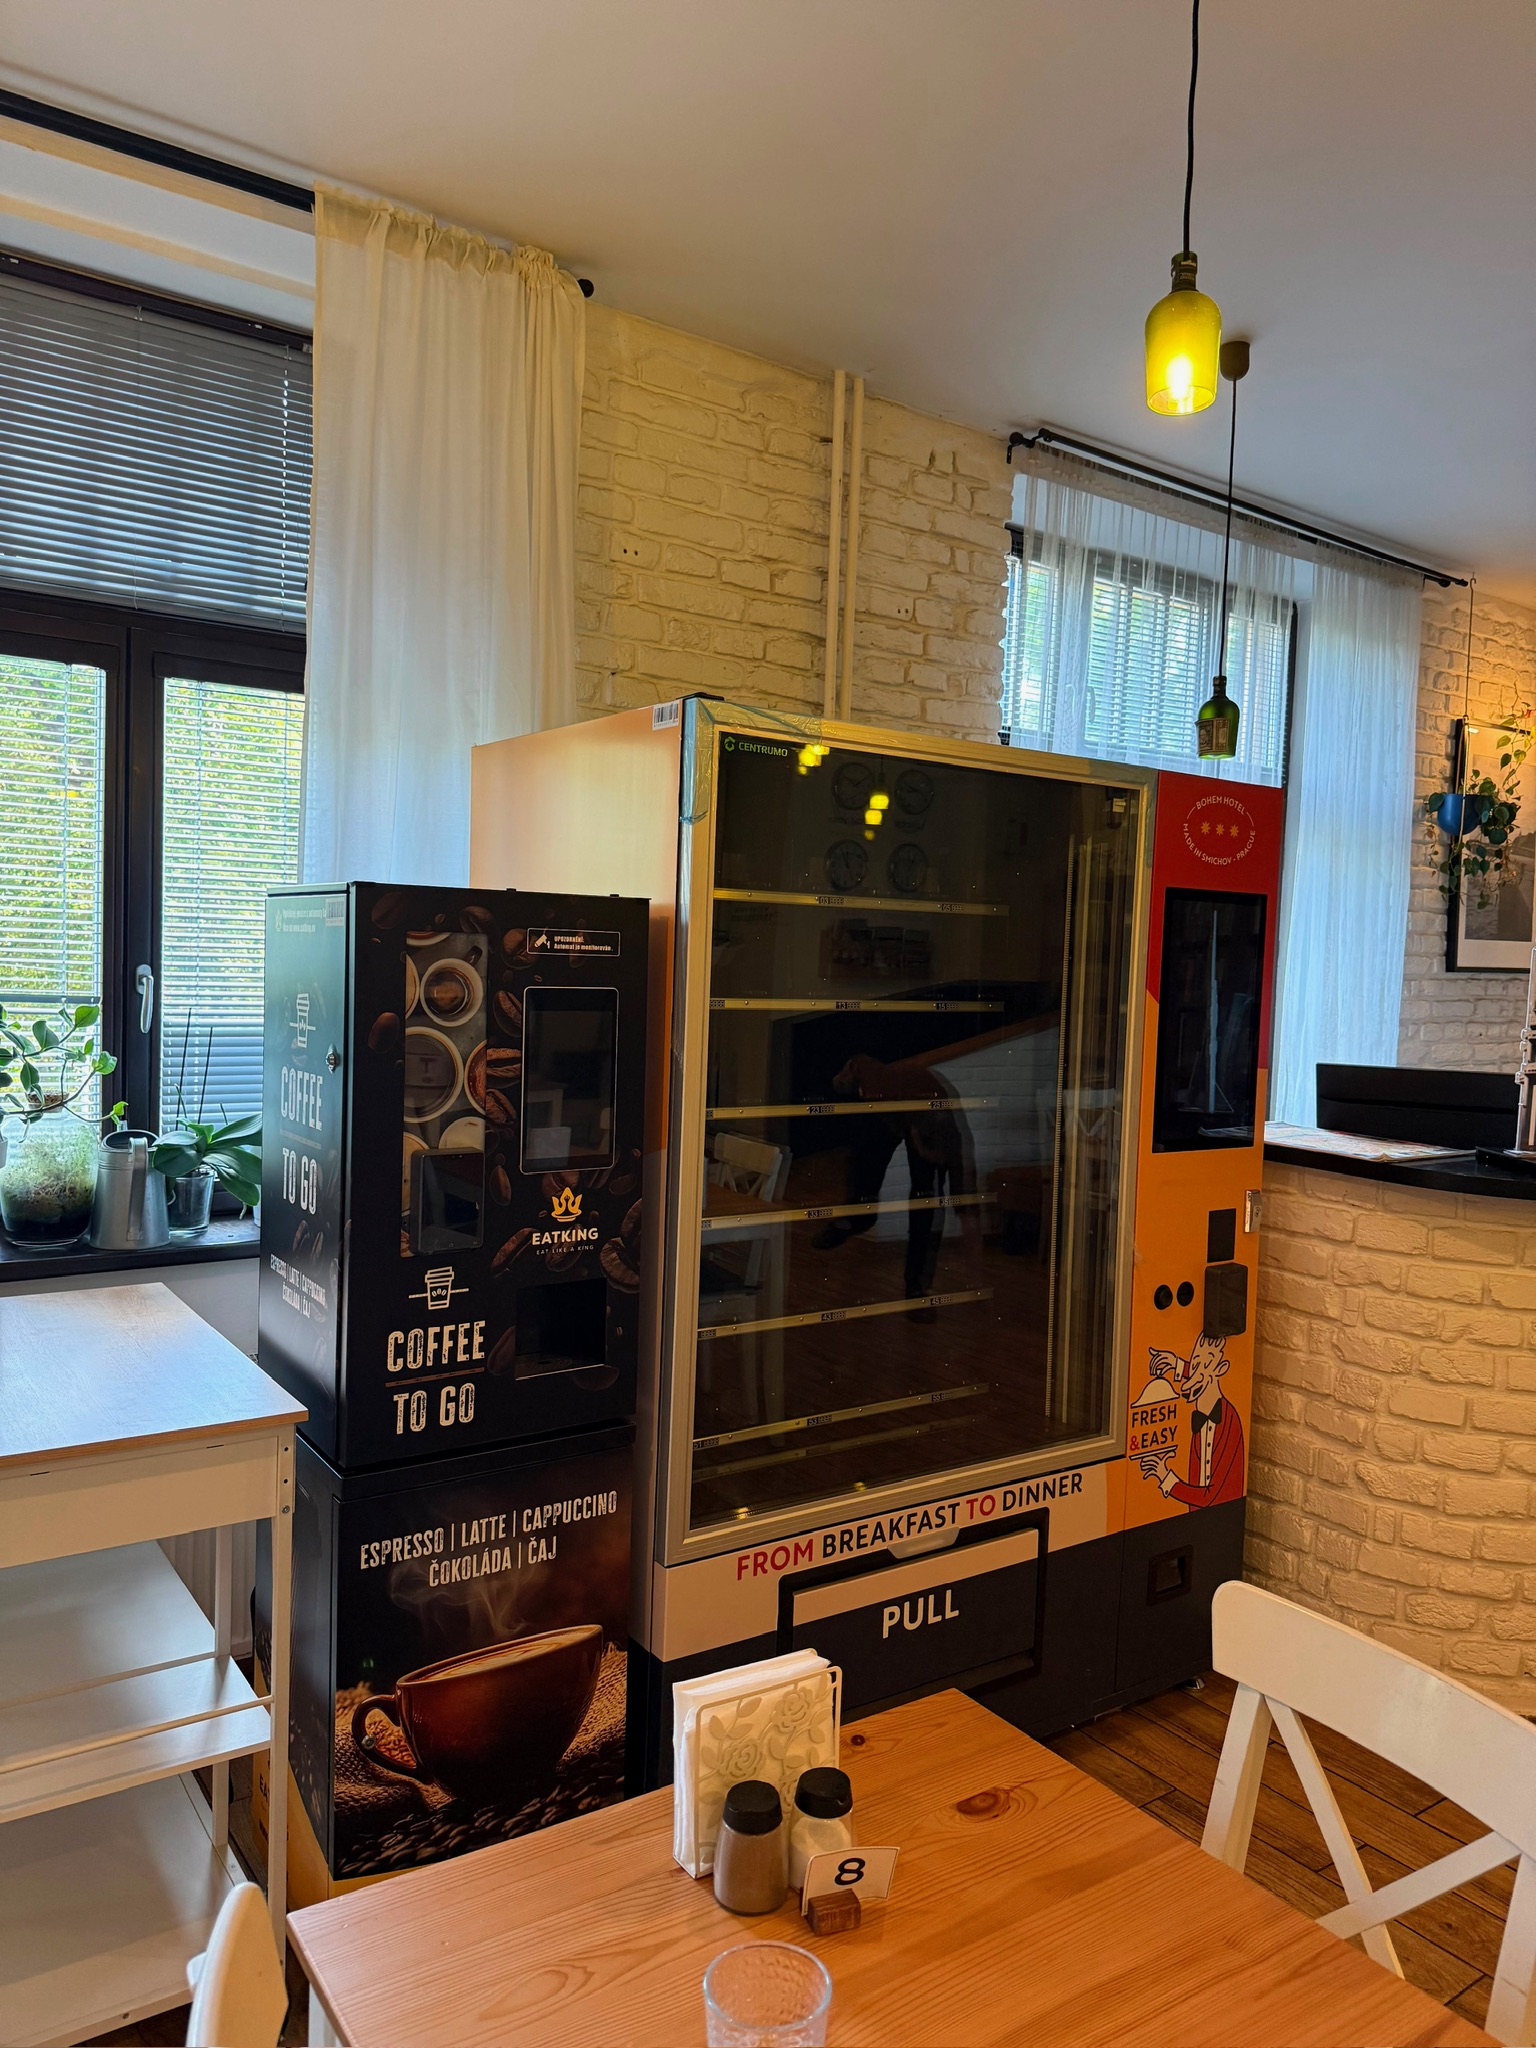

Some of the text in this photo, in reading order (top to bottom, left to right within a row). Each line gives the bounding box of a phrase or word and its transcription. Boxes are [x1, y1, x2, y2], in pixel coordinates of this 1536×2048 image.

[738, 741, 788, 757] CENTRUMO
[1196, 795, 1245, 815] BOHEM HOTEL
[1183, 823, 1256, 865] MADE IN SMICHOV PRAGUE
[280, 1066, 323, 1131] COFFEE
[282, 1147, 317, 1215] TO GO
[532, 1227, 599, 1246] EATKING
[536, 1248, 549, 1256] EAT
[386, 1320, 486, 1372] COFFEE
[393, 1382, 476, 1435] TO GO
[1131, 1403, 1177, 1428] FRESH
[1129, 1425, 1178, 1451] &EASY
[360, 1490, 618, 1570] ESPRESSO LATTE CAPPUCCINO
[736, 1472, 1083, 1581] FROM BREAKFAST TO DINNER
[429, 1535, 558, 1588] ČOKOLÁDA ČAJ
[882, 1589, 960, 1639] PULL
[834, 1857, 866, 1886] 8
